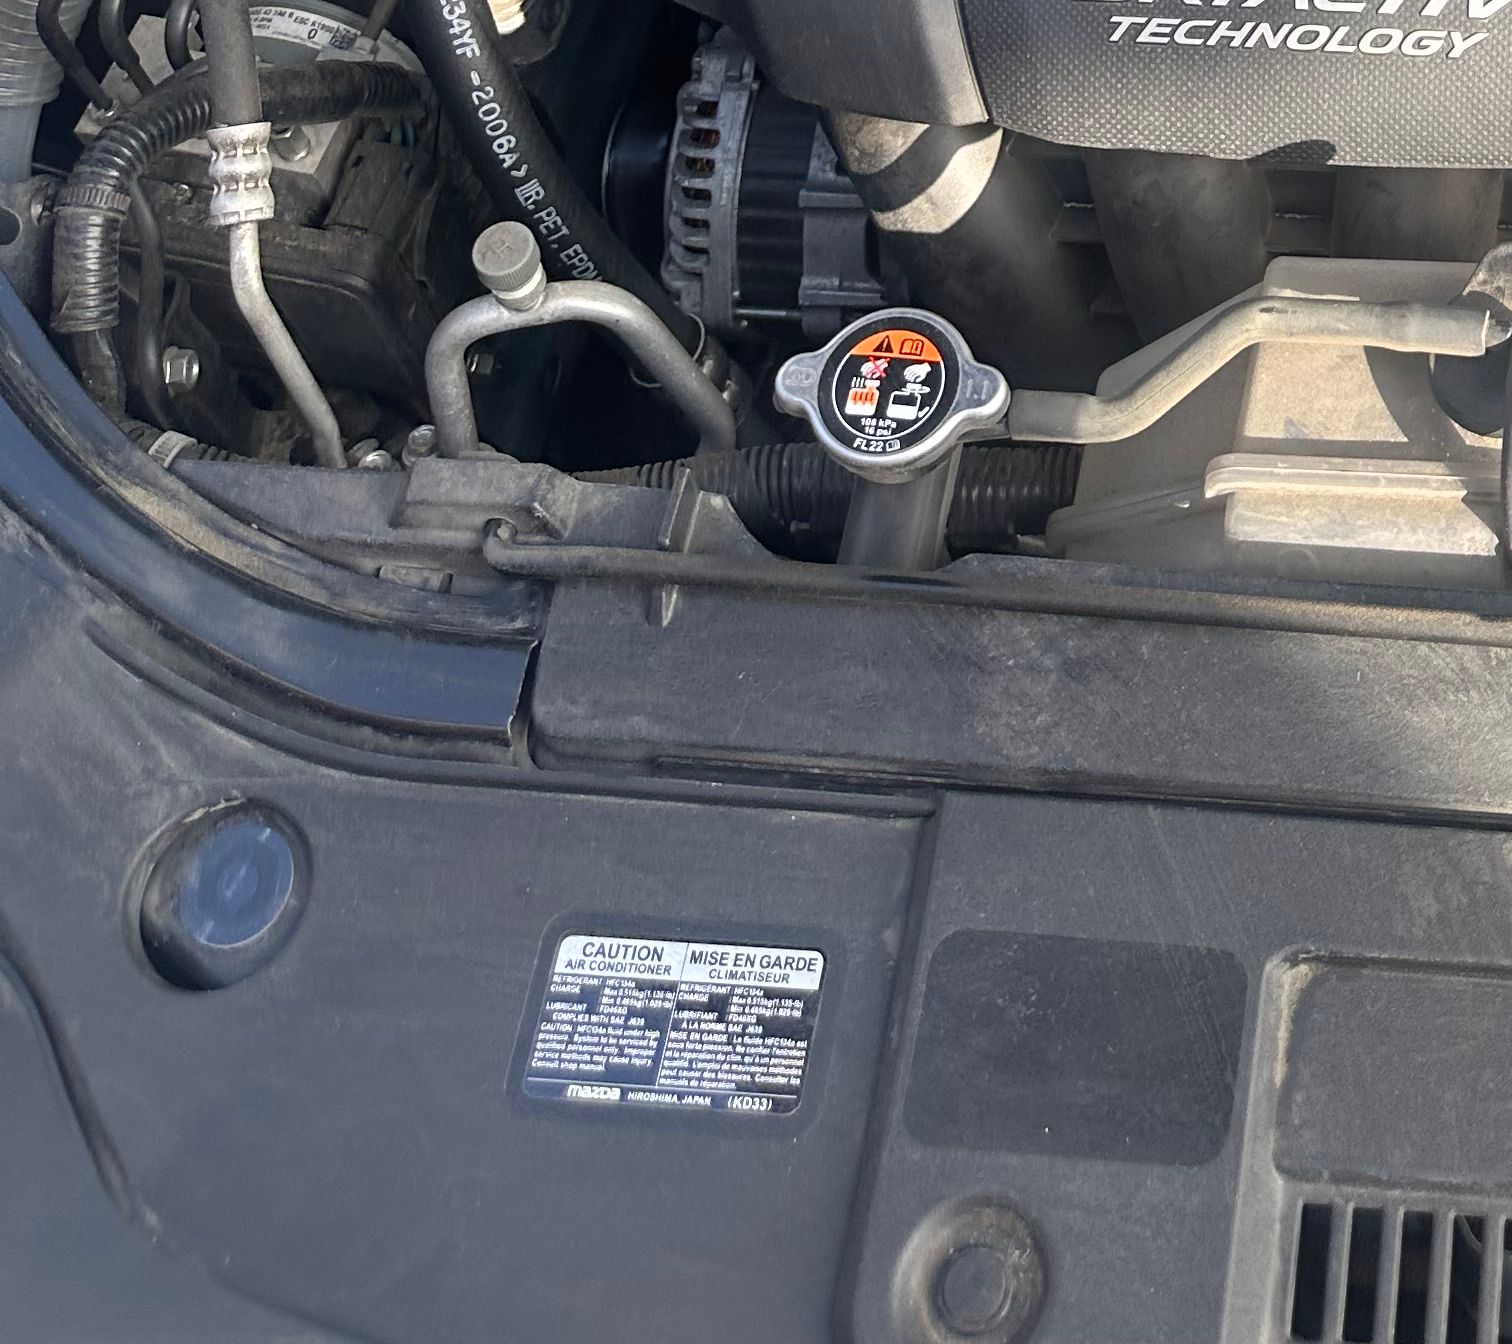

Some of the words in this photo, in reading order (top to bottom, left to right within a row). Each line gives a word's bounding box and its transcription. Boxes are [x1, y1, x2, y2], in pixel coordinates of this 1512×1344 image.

[1108, 16, 1490, 59] TECHNOLOGY
[864, 426, 875, 435] 16
[878, 418, 897, 429] kPa
[852, 437, 884, 452] FL22
[582, 942, 665, 962] CAUTION
[565, 959, 586, 971] AIR
[589, 960, 672, 976] CONDITIONER
[689, 950, 730, 966] MISE
[733, 953, 757, 968] EN
[760, 955, 819, 972] GARDE
[708, 968, 791, 984] CLIMATISEUR
[546, 1001, 587, 1011] LUBRICANT
[567, 1084, 622, 1100] mazda
[628, 1091, 681, 1104] HIROSHIMA,
[681, 1094, 712, 1105] JAPAN
[728, 1096, 773, 1111] (KD33)
